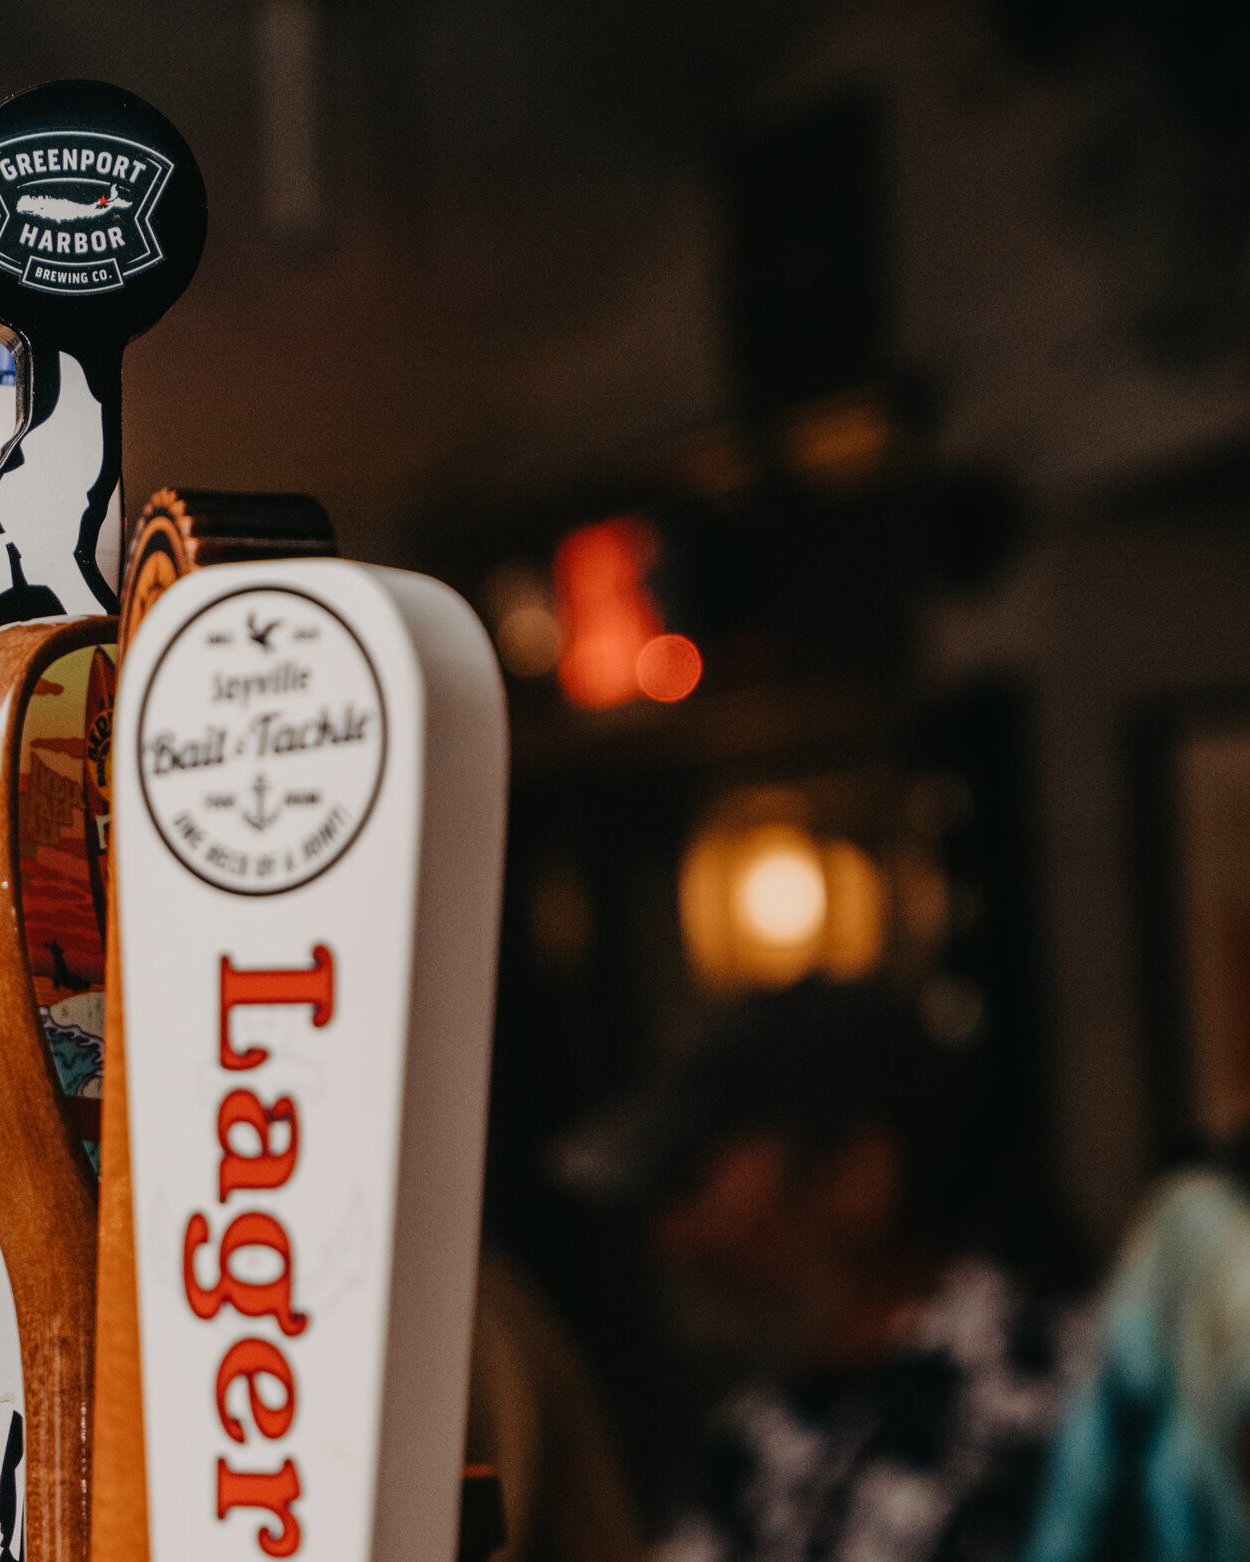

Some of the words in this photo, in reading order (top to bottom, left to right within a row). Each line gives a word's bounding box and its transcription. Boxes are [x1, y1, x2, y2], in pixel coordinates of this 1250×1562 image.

[0, 149, 146, 183] GREENPORT
[19, 223, 125, 254] HARBOR
[35, 266, 88, 283] BREWING
[92, 268, 112, 281] CO.
[183, 942, 334, 1558] Lager
